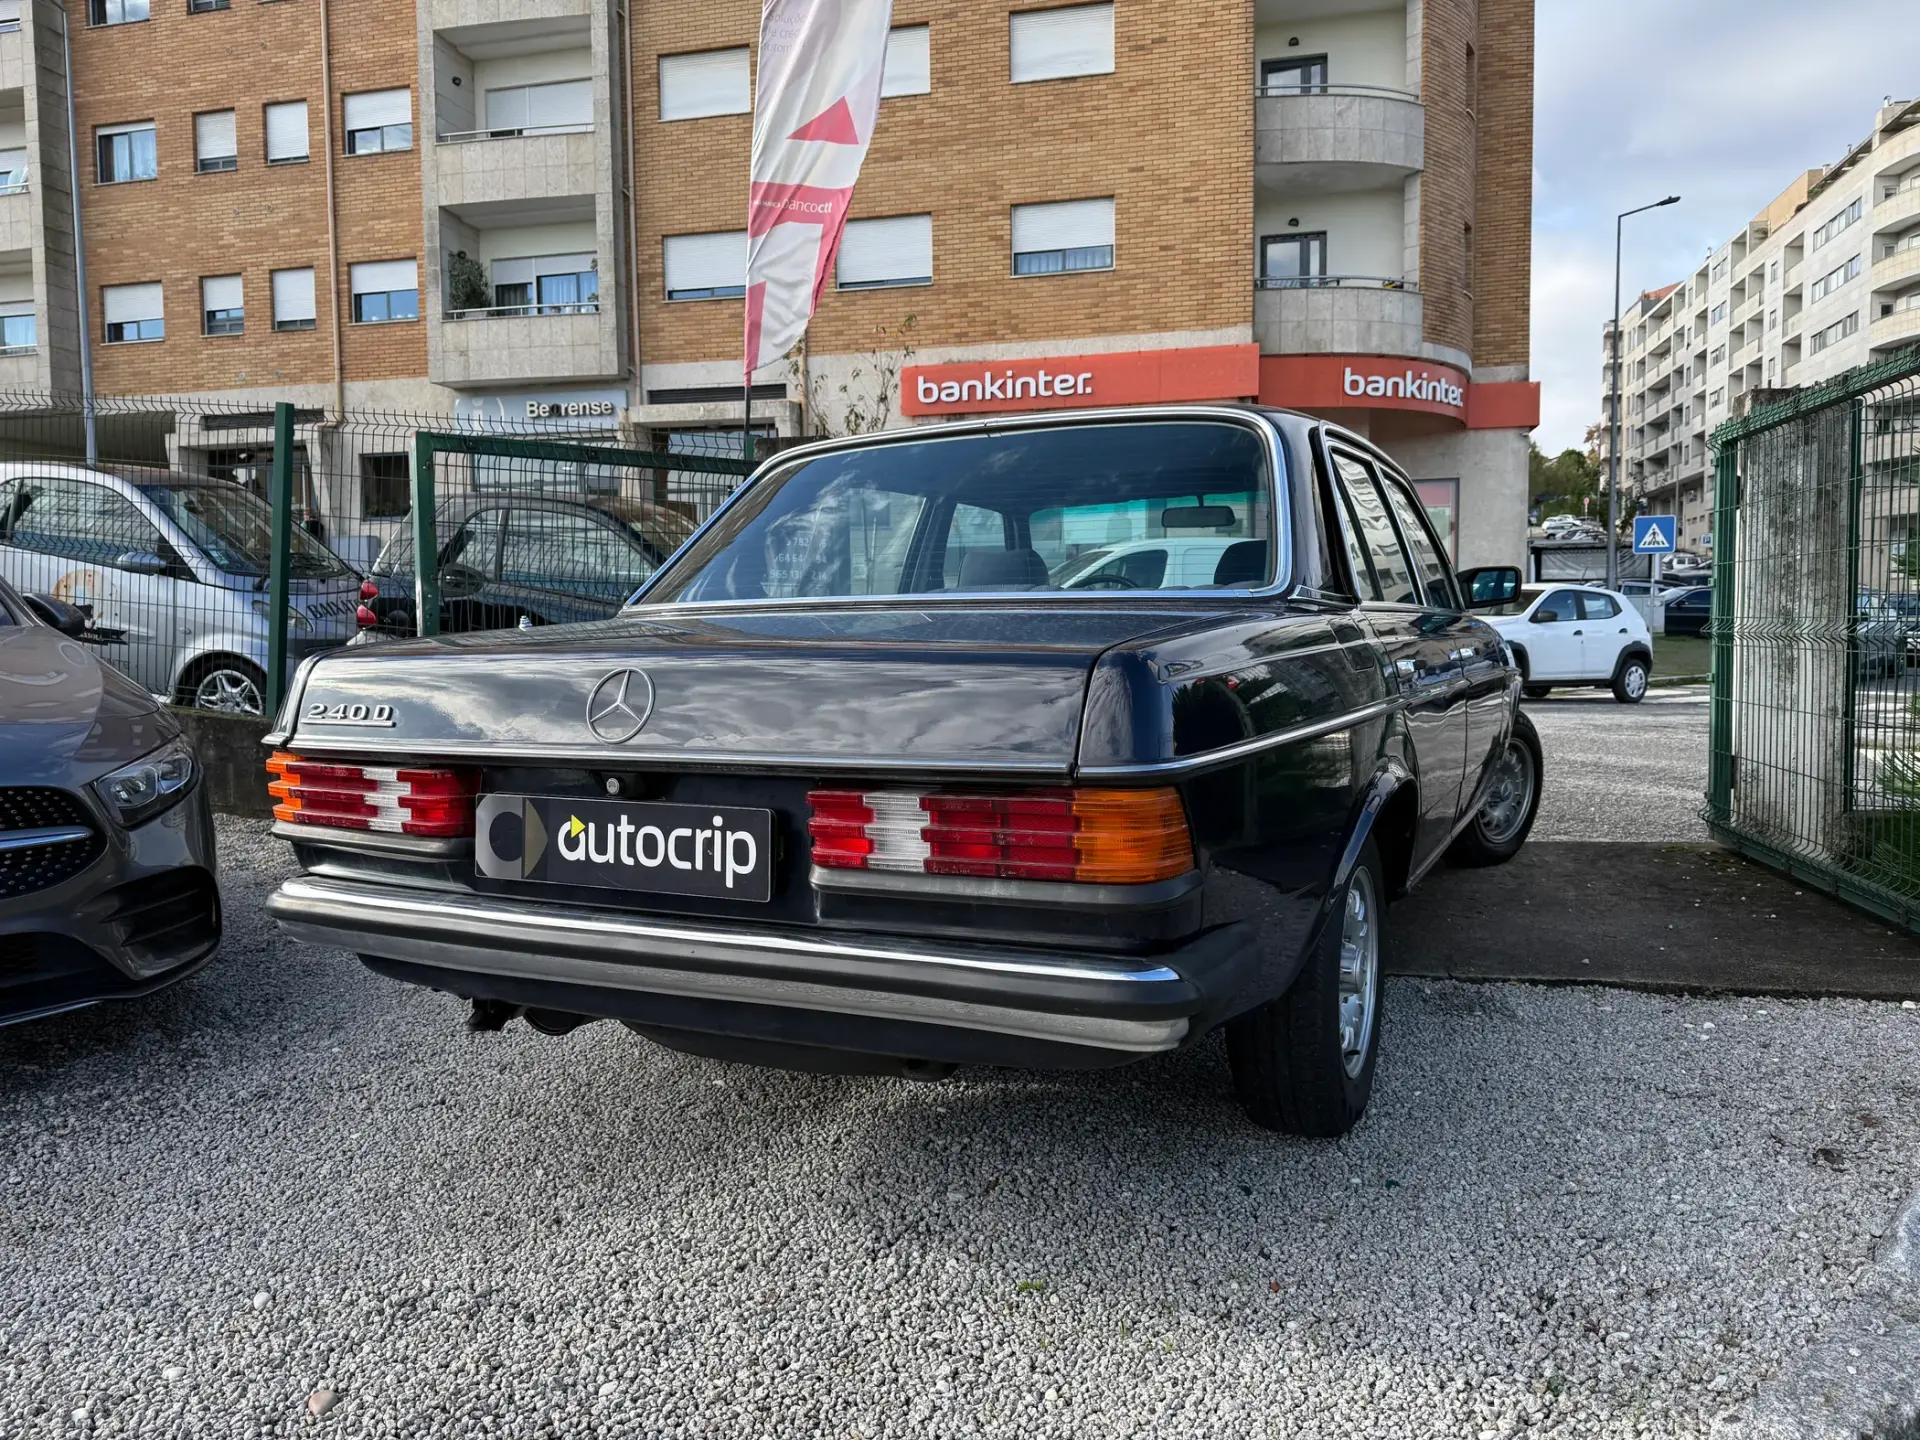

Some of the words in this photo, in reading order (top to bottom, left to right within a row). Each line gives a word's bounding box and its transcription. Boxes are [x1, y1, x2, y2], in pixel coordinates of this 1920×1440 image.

[917, 370, 1092, 404] bankinter.
[306, 702, 371, 721] 240
[373, 704, 395, 721] D
[557, 814, 757, 889] autocrip
